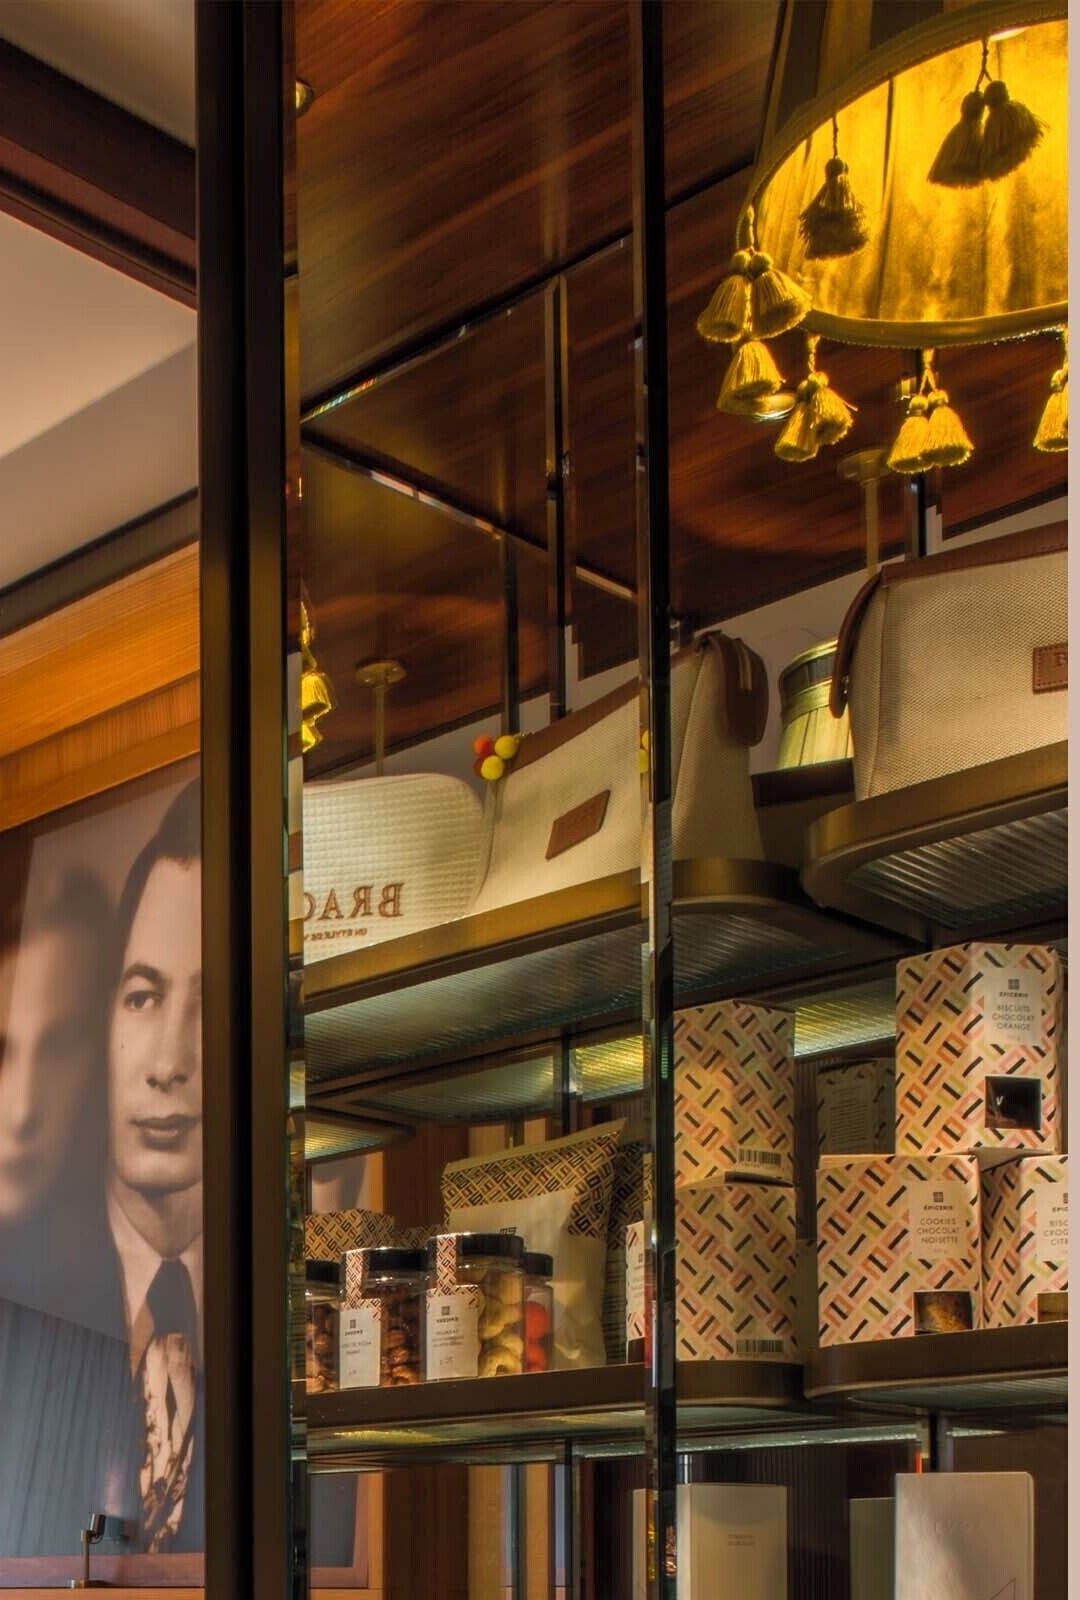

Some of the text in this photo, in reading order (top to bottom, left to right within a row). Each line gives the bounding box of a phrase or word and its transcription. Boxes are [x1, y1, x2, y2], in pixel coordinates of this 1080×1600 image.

[992, 1013, 1034, 1021] CHOCOLAT
[996, 1023, 1030, 1031] ORANGE
[920, 1217, 956, 1225] COOKIES
[916, 1227, 960, 1235] CHOCOLAT
[921, 1236, 958, 1244] NOISETTE
